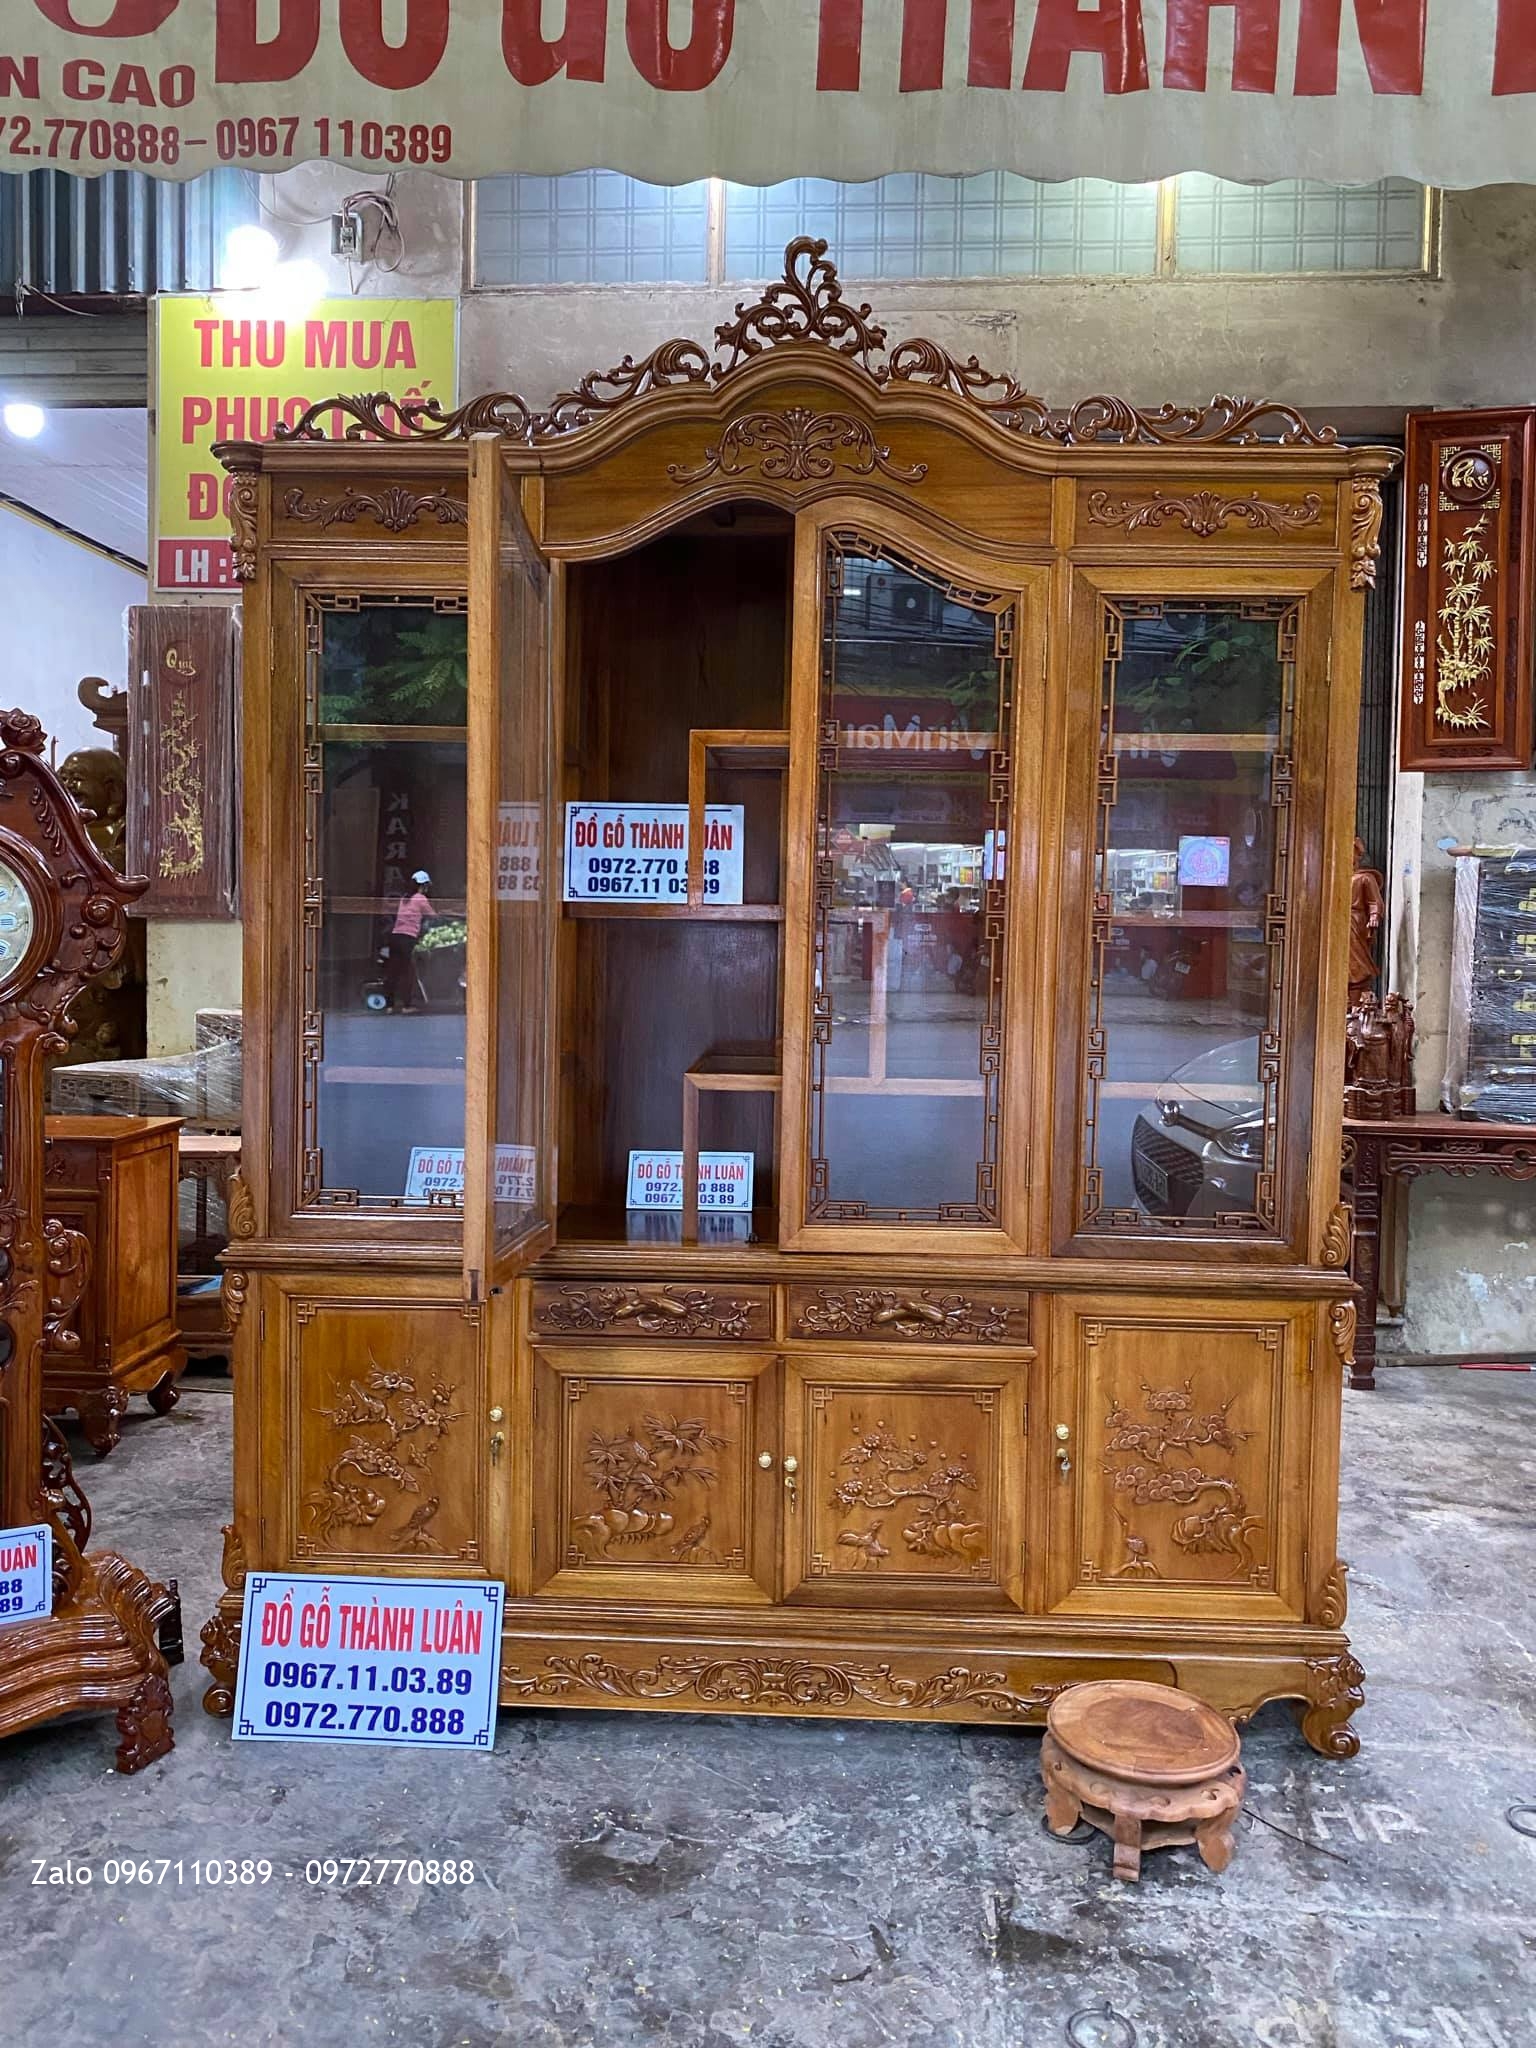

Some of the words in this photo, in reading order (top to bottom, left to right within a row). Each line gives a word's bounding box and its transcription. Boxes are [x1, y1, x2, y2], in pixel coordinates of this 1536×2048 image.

[62, 59, 196, 108] CAO
[0, 115, 180, 165] 2.770888
[216, 116, 299, 161] 0967
[314, 119, 452, 163] 110389
[194, 320, 285, 368] THU
[304, 320, 417, 369] MUA
[575, 812, 598, 848] ĐỒ
[603, 813, 625, 848] GỖ
[630, 819, 684, 849] THÀNH
[588, 858, 678, 875] 0972.770
[588, 877, 660, 894] 0967.11
[638, 1158, 653, 1179] ĐỒ
[715, 1162, 744, 1180] LUÂN
[700, 1194, 715, 1204] 03
[719, 1195, 735, 1204] 89
[711, 1183, 735, 1193] 888
[261, 1587, 294, 1648] ĐỒ
[300, 1586, 332, 1649] GỖ
[339, 1597, 416, 1653] THÀNH
[420, 1600, 483, 1655] LUÂN
[264, 1661, 473, 1696] 0967.11.03.89
[265, 1701, 466, 1735] 0972.770.888
